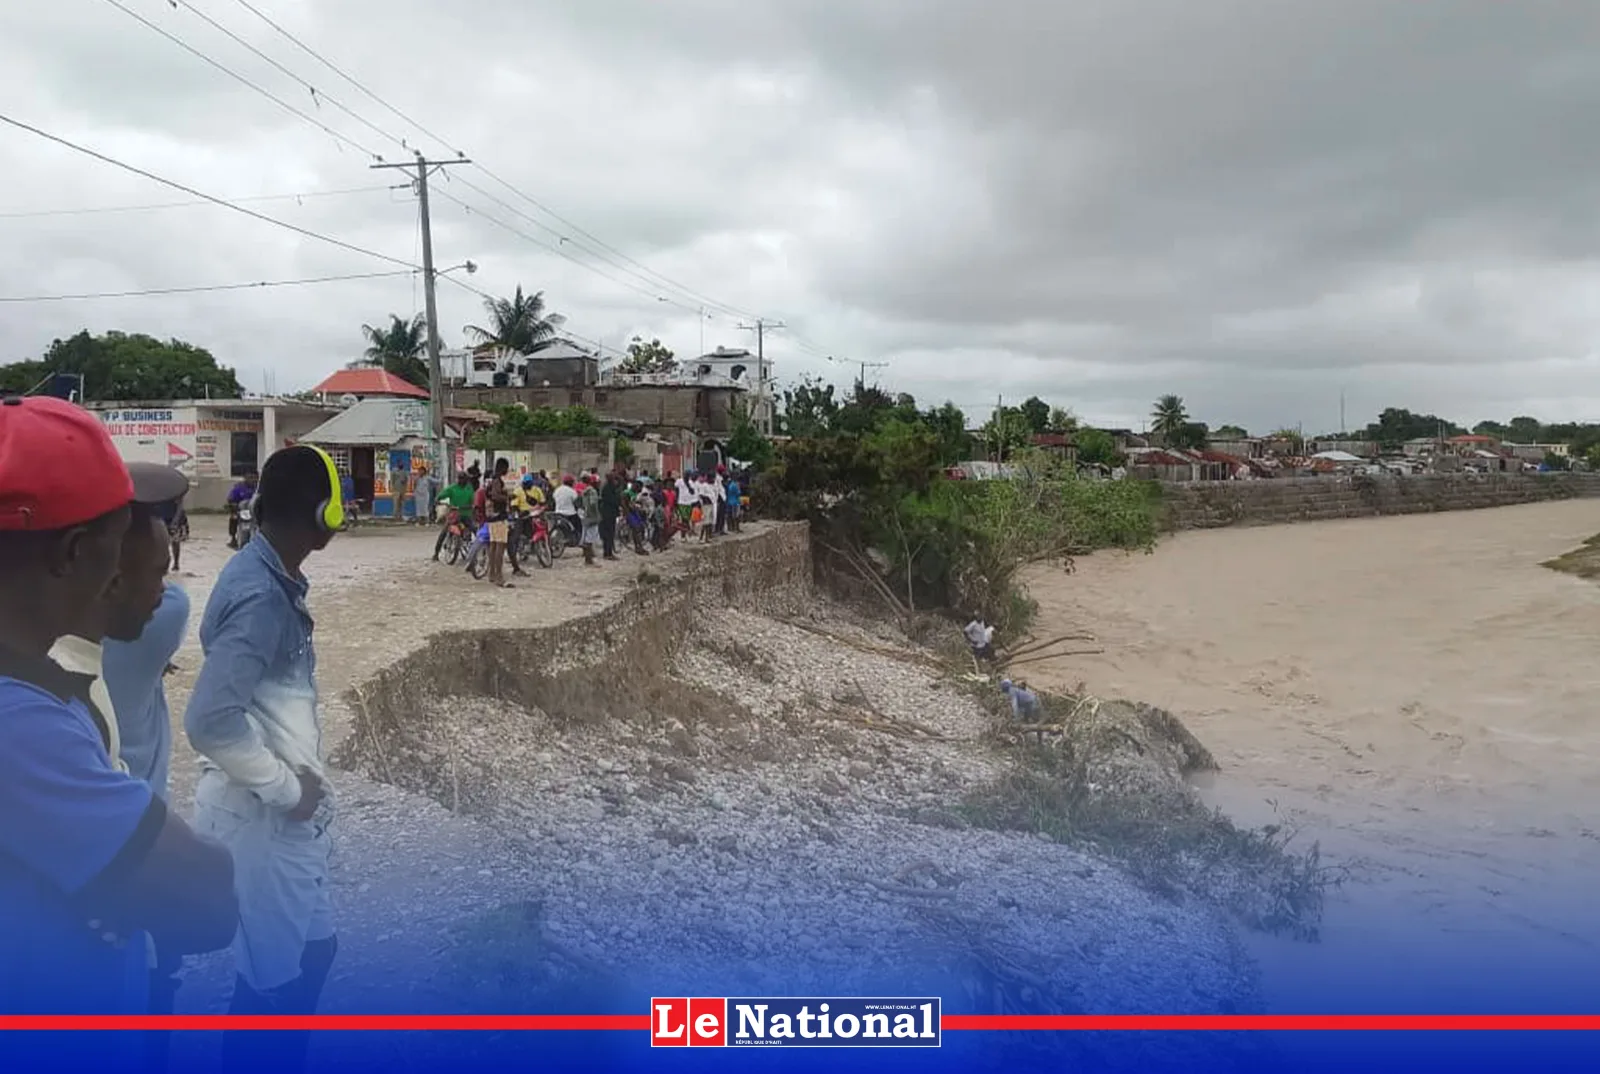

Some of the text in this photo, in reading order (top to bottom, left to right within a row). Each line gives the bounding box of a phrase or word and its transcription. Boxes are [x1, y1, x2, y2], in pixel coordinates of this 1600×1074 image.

[123, 411, 172, 421] BUSINESS
[126, 424, 136, 436] DE
[138, 424, 196, 436] CONSTRUCTION
